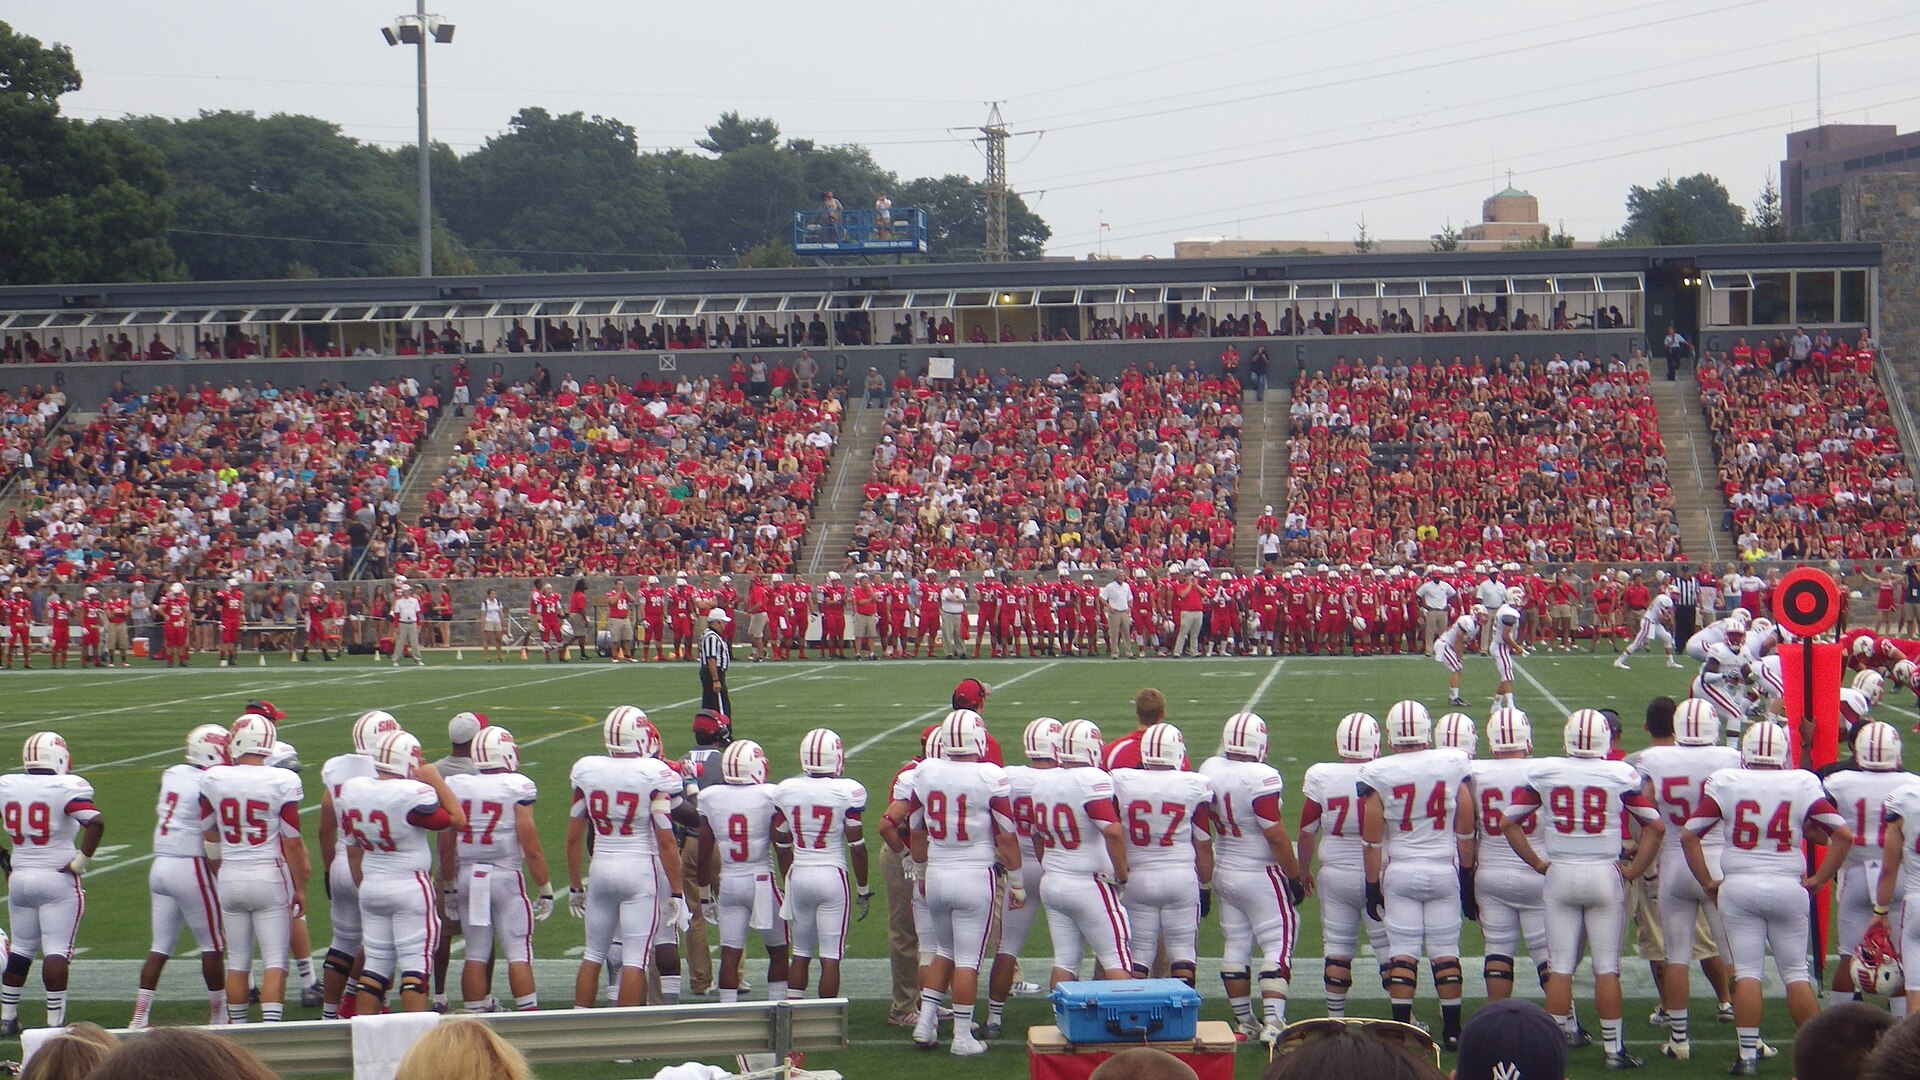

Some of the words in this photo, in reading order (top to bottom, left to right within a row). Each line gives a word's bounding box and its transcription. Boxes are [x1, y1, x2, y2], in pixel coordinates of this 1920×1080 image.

[835, 355, 847, 370] D
[898, 354, 909, 369] E
[1296, 344, 1305, 360] F
[1629, 337, 1638, 353] F
[1707, 335, 1720, 351] G
[55, 370, 65, 386] B
[5, 801, 51, 846] 99
[160, 792, 179, 836] 7
[220, 798, 269, 845] 95
[589, 790, 639, 836] 87
[927, 790, 969, 841] 91
[1127, 800, 1185, 847] 67
[1393, 781, 1446, 832] 74
[1550, 786, 1607, 834] 98
[1662, 776, 1706, 826] 5
[728, 814, 749, 862] 9
[791, 805, 833, 849] 17
[1732, 799, 1792, 852] 64
